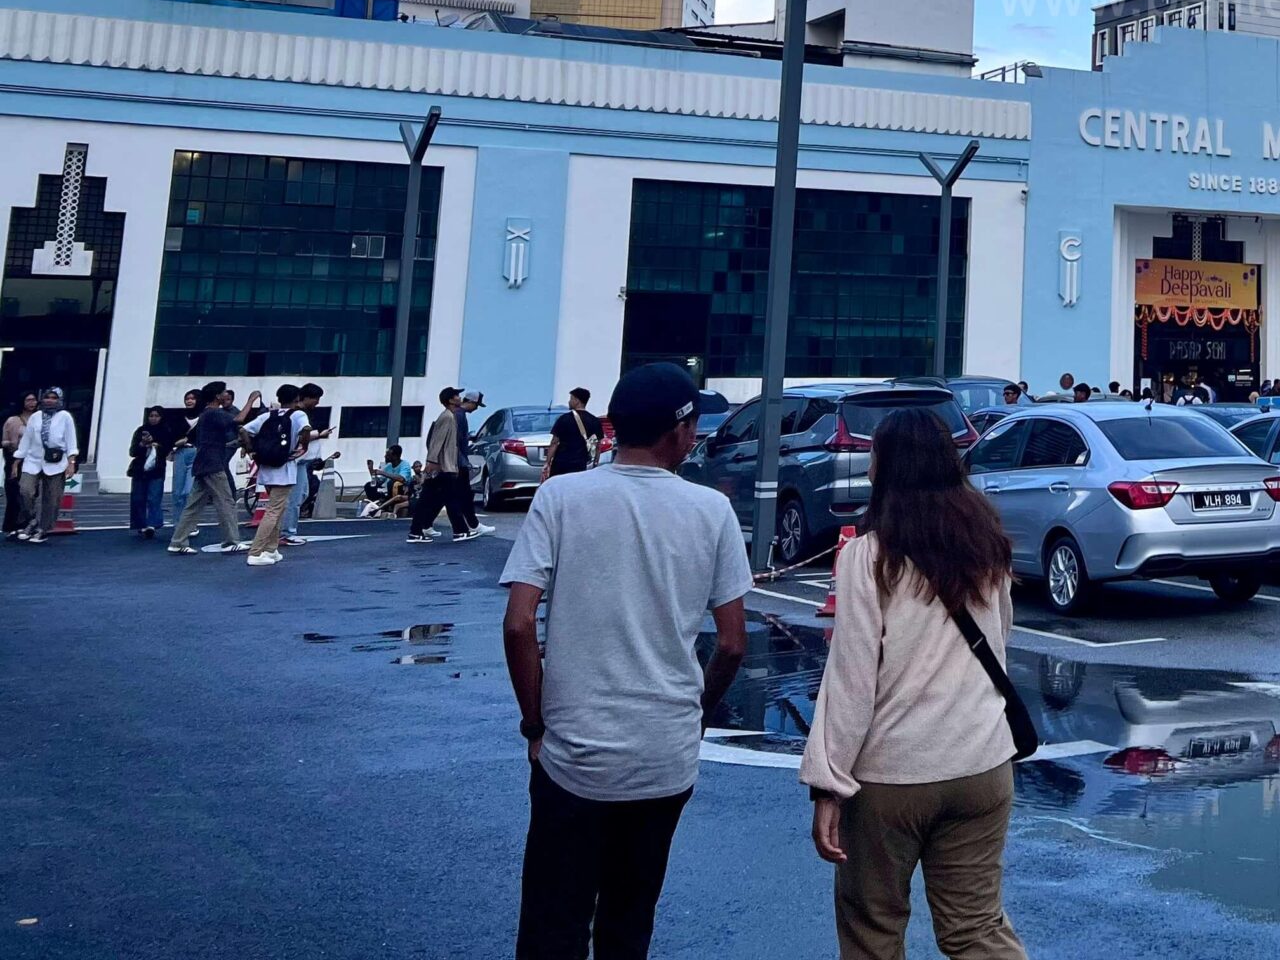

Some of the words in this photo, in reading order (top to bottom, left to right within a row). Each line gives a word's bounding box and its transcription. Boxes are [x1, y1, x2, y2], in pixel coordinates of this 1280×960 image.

[1079, 107, 1232, 158] CENTRAL
[1188, 172, 1242, 192] SINCE
[1164, 265, 1205, 285] Happy
[1161, 278, 1232, 303] Deepavali
[1204, 495, 1221, 507] VLH
[1225, 493, 1242, 505] 894
